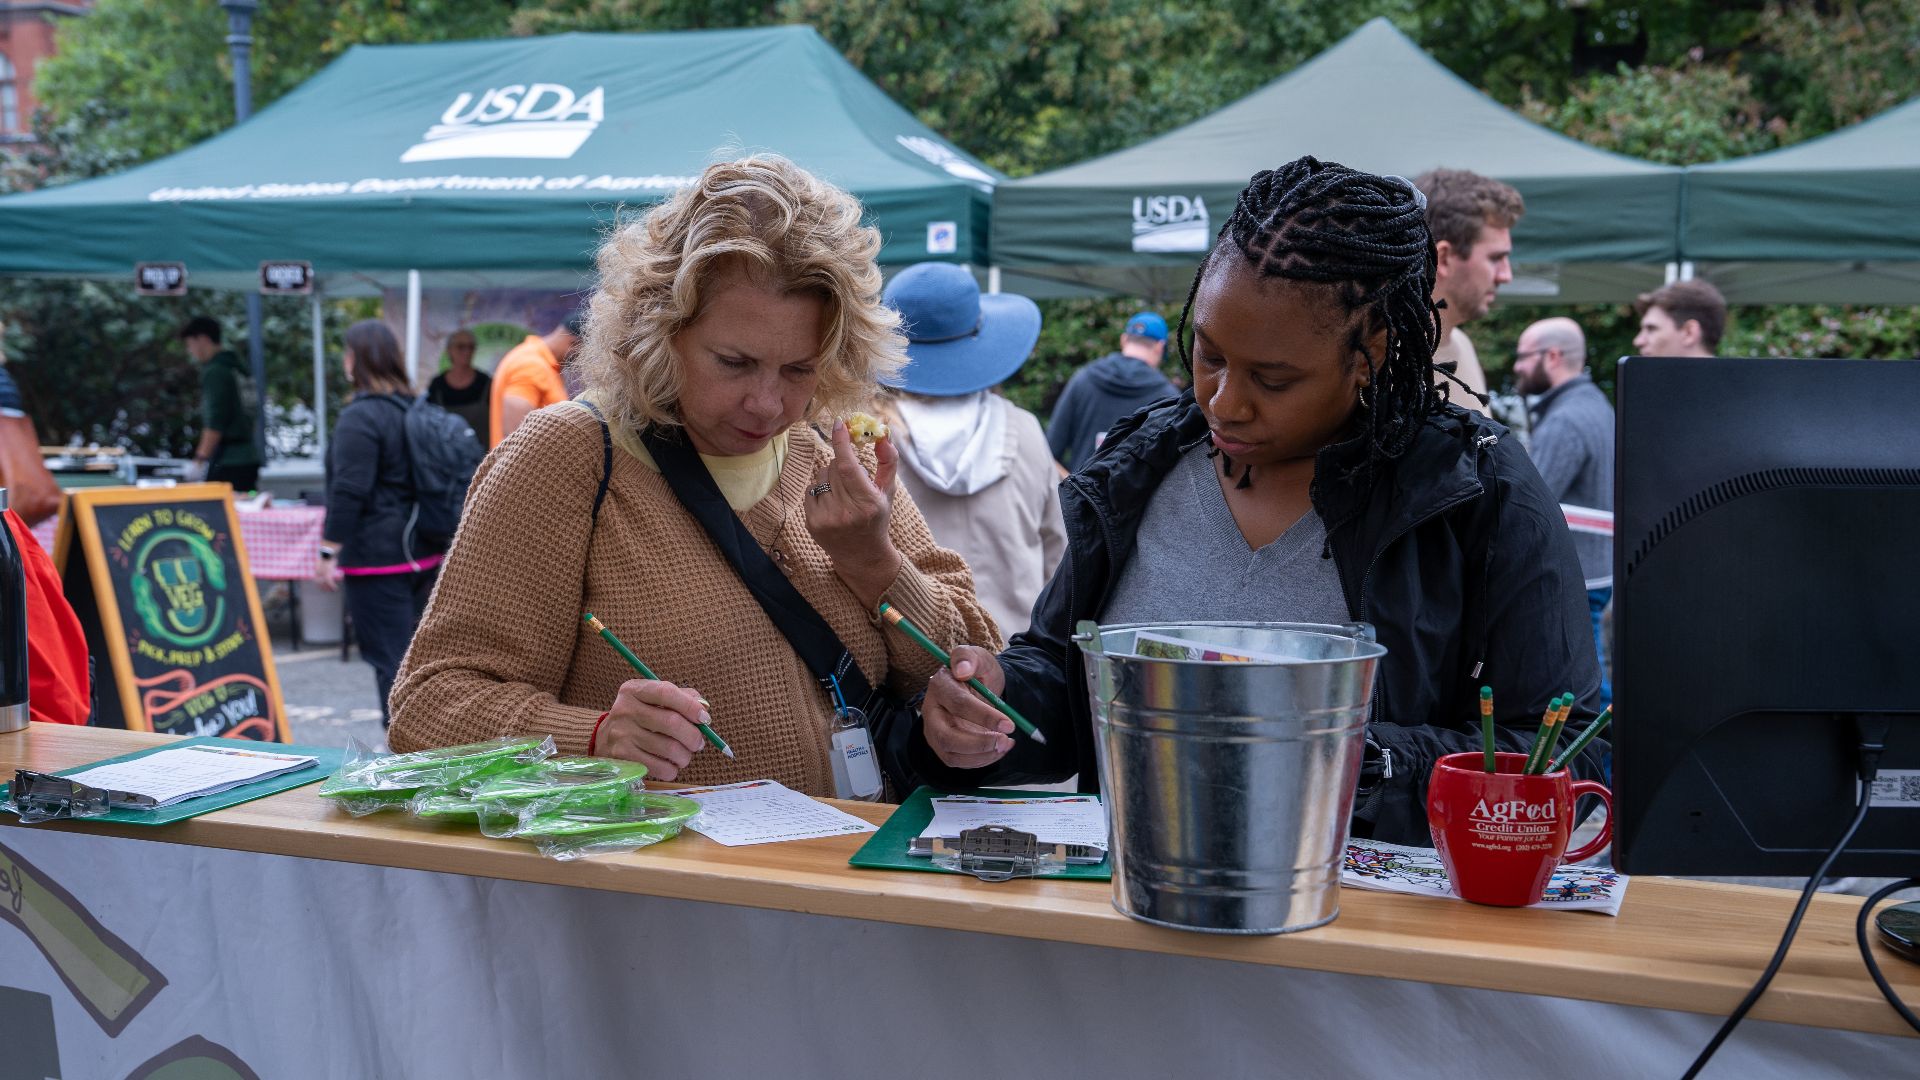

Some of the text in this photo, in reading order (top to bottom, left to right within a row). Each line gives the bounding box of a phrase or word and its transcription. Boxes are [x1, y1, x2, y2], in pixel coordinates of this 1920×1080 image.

[441, 83, 605, 125] USDA
[1132, 194, 1209, 224] USDA
[1470, 798, 1556, 823] AgFed
[1475, 822, 1550, 834] Credit Union
[1478, 833, 1495, 841] Your
